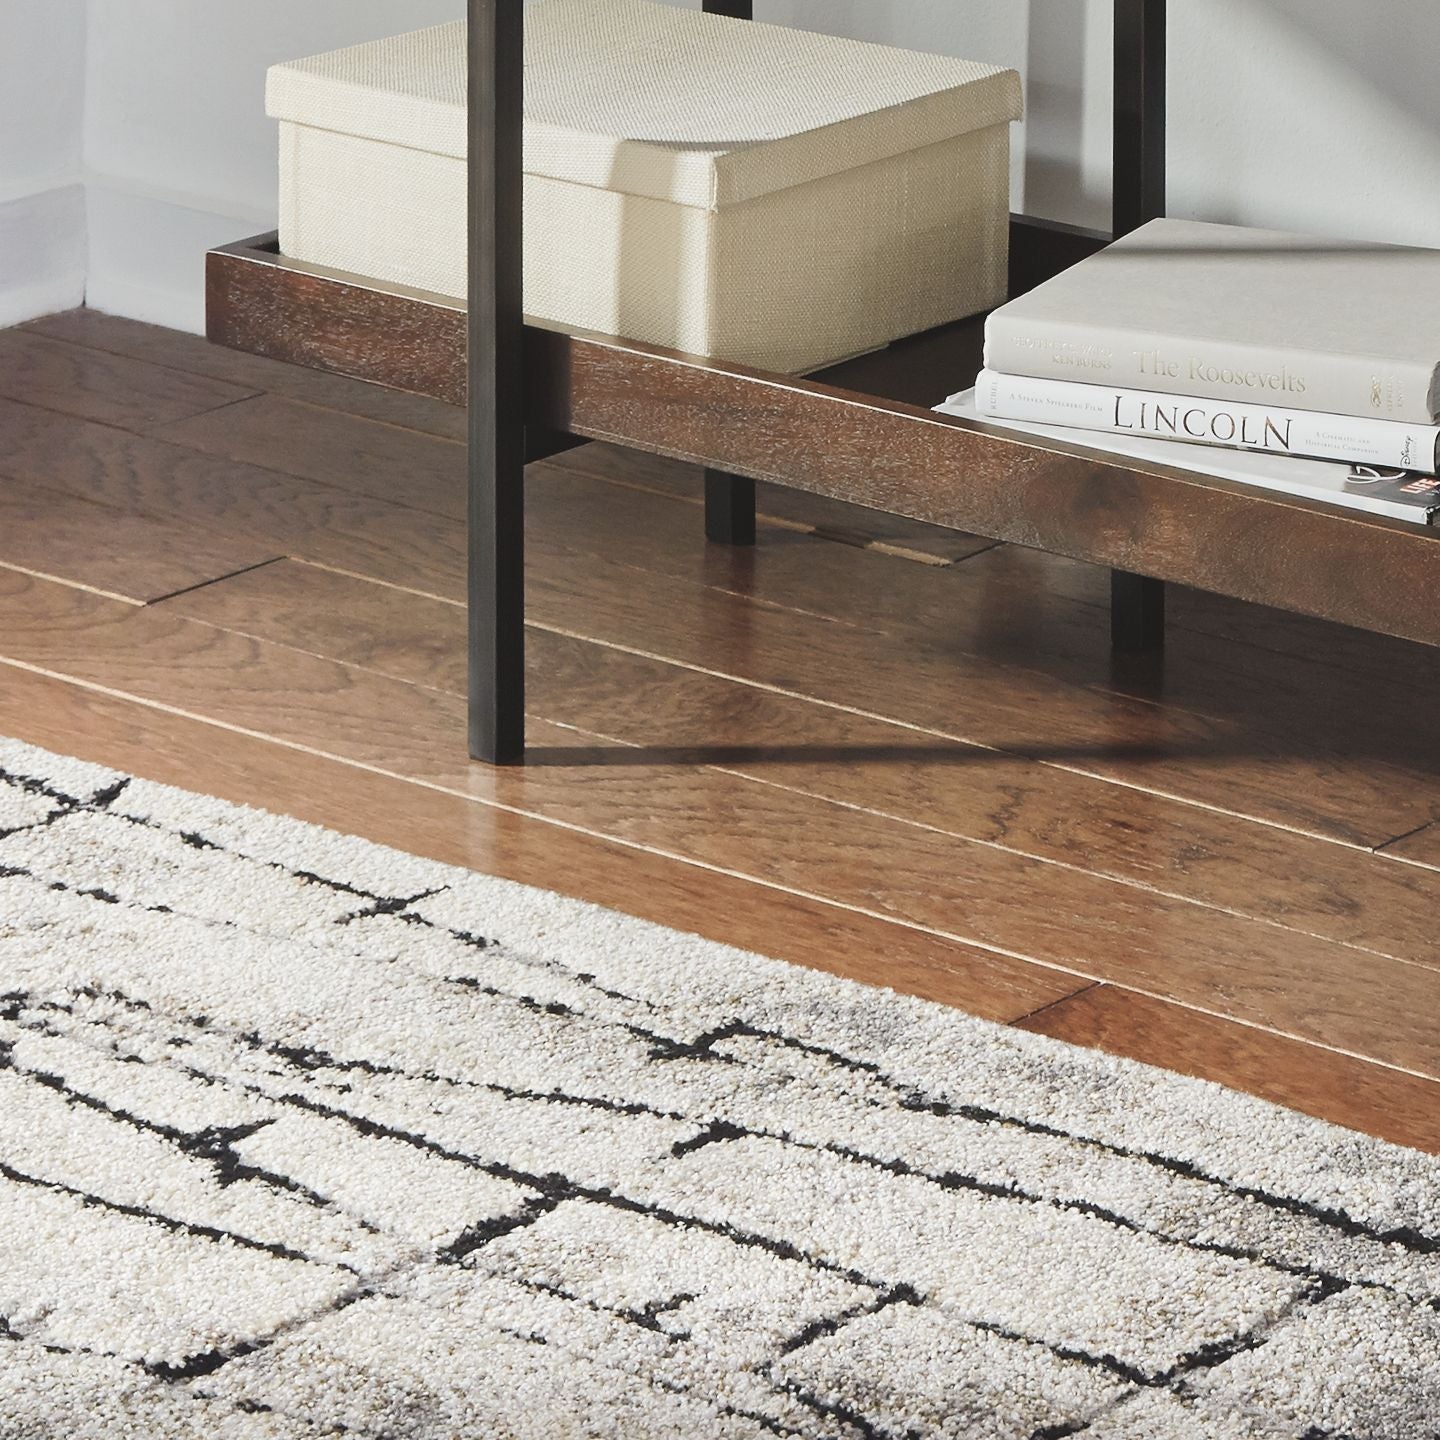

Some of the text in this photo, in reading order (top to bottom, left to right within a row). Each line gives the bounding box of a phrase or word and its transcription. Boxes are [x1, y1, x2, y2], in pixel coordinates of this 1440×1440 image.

[1076, 357, 1113, 370] BURNS
[1131, 349, 1306, 393] The Roosevelts
[1113, 395, 1295, 450] LINCOLN
[1400, 434, 1414, 469] Disney
